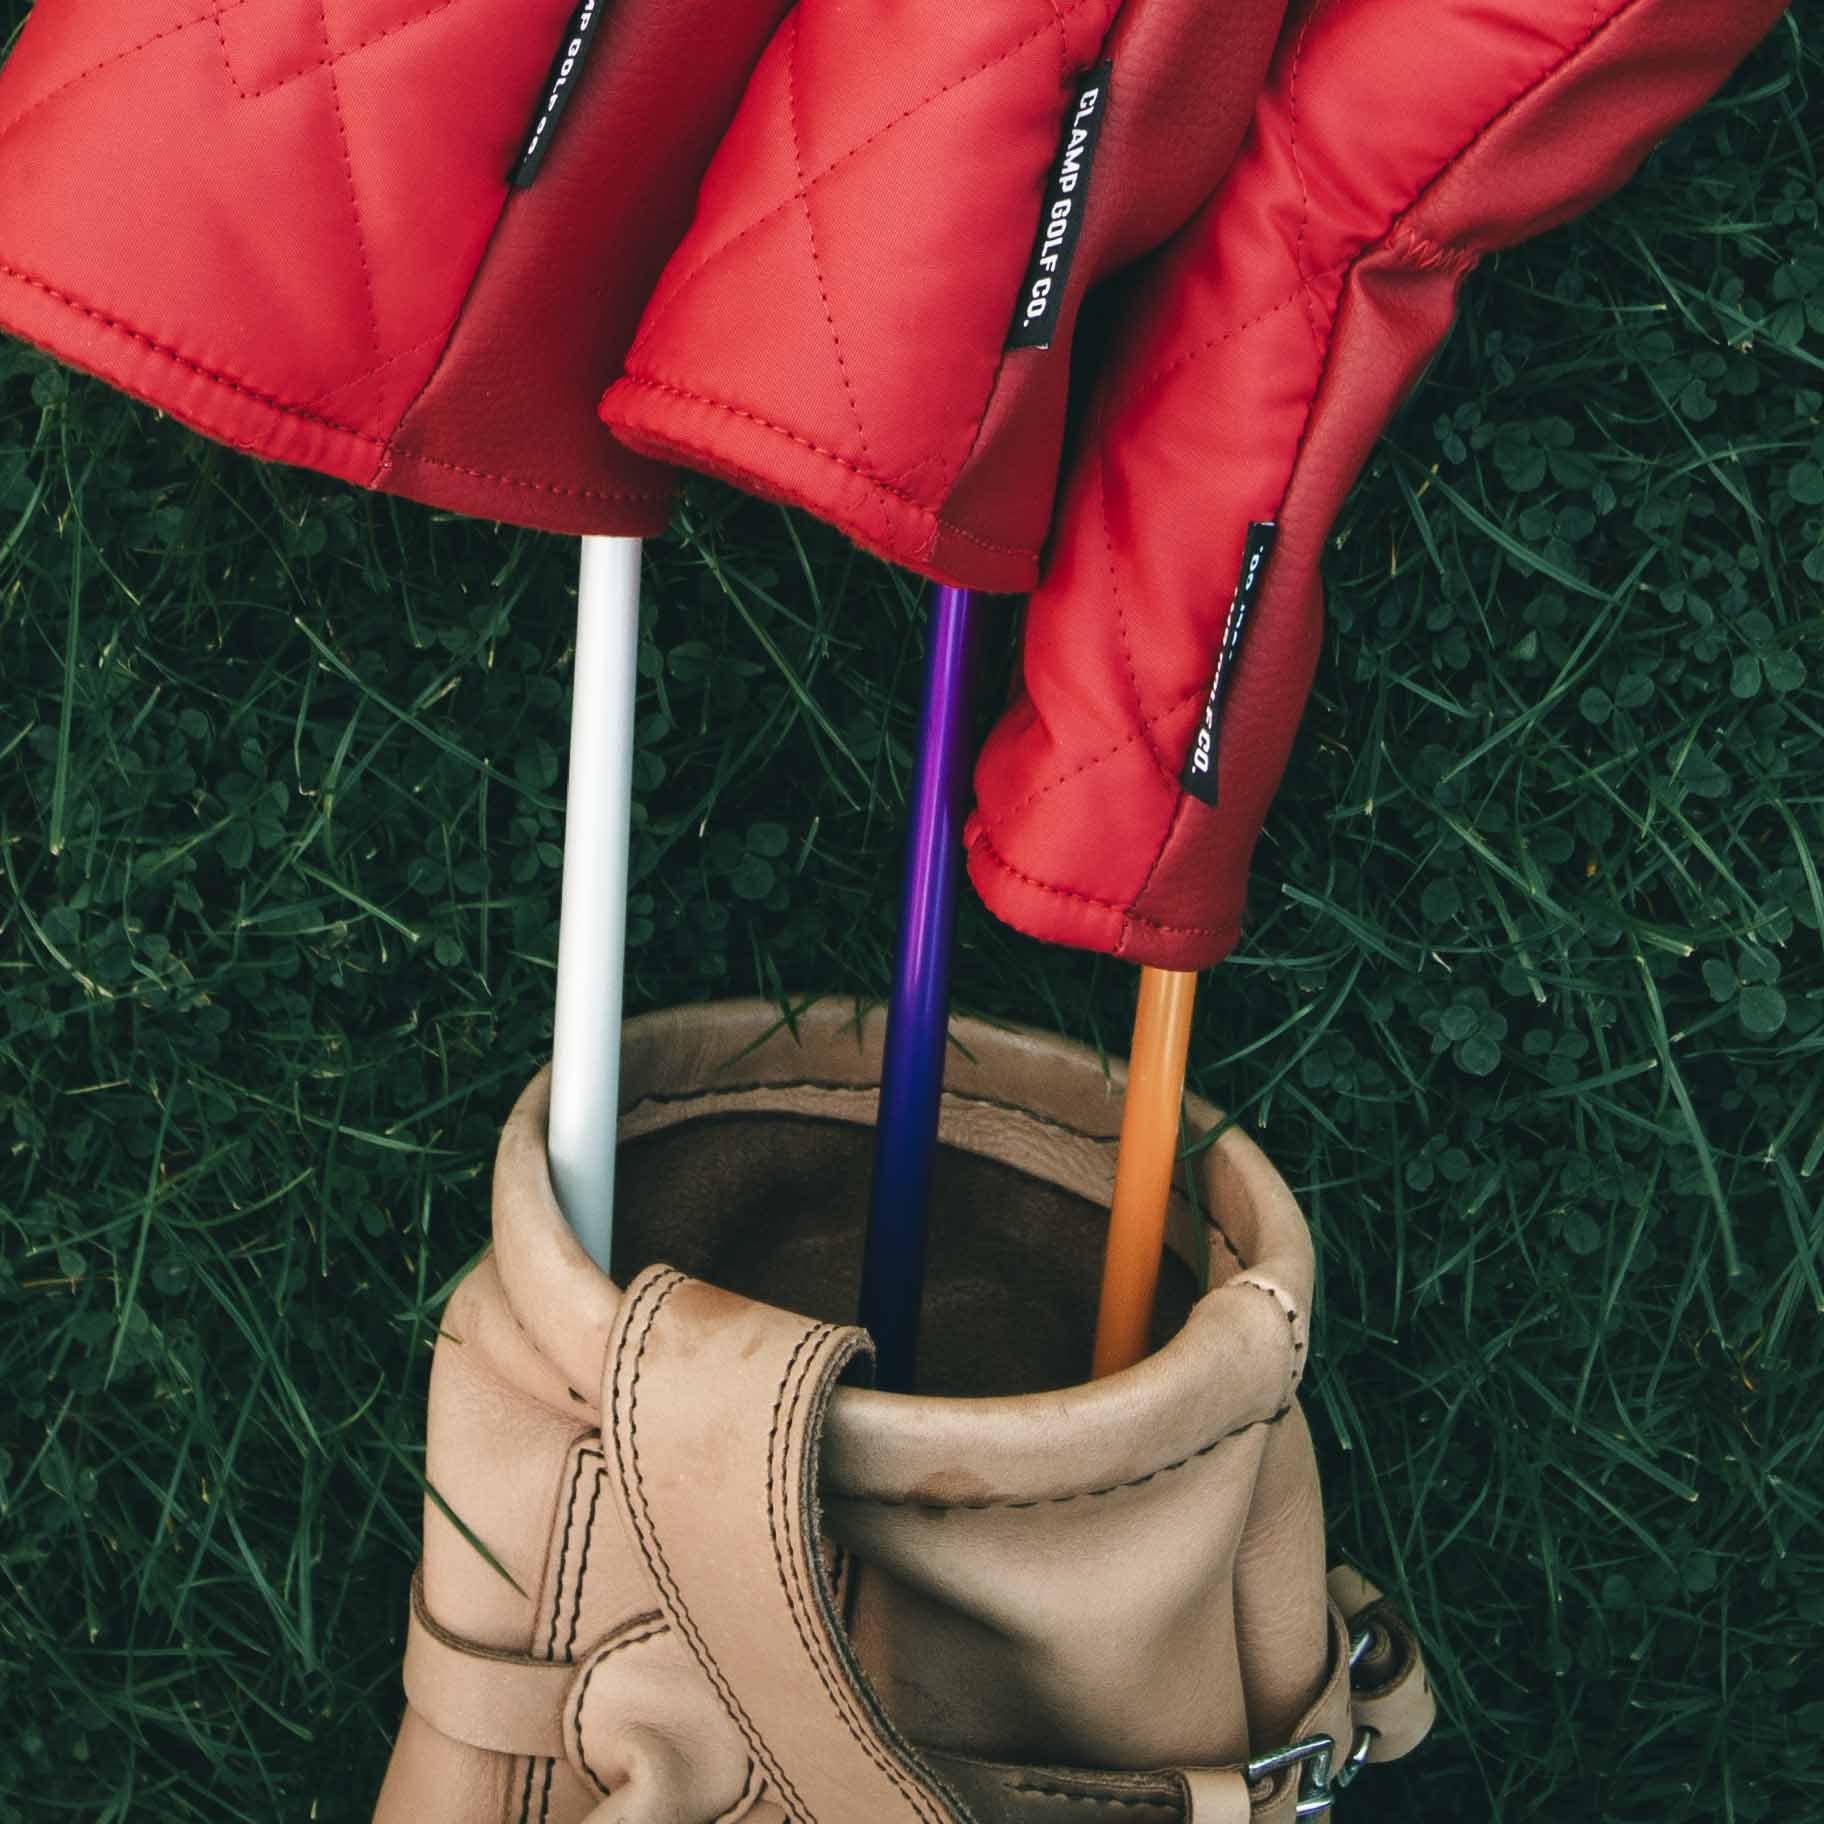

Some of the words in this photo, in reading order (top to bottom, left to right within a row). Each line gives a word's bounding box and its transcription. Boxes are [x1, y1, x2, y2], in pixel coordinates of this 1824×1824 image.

[547, 38, 583, 113] GOLF
[1059, 87, 1100, 192] CLAMP
[1040, 198, 1071, 273] GOLF
[1023, 277, 1051, 328] CO.
[1191, 728, 1211, 774] CO.
